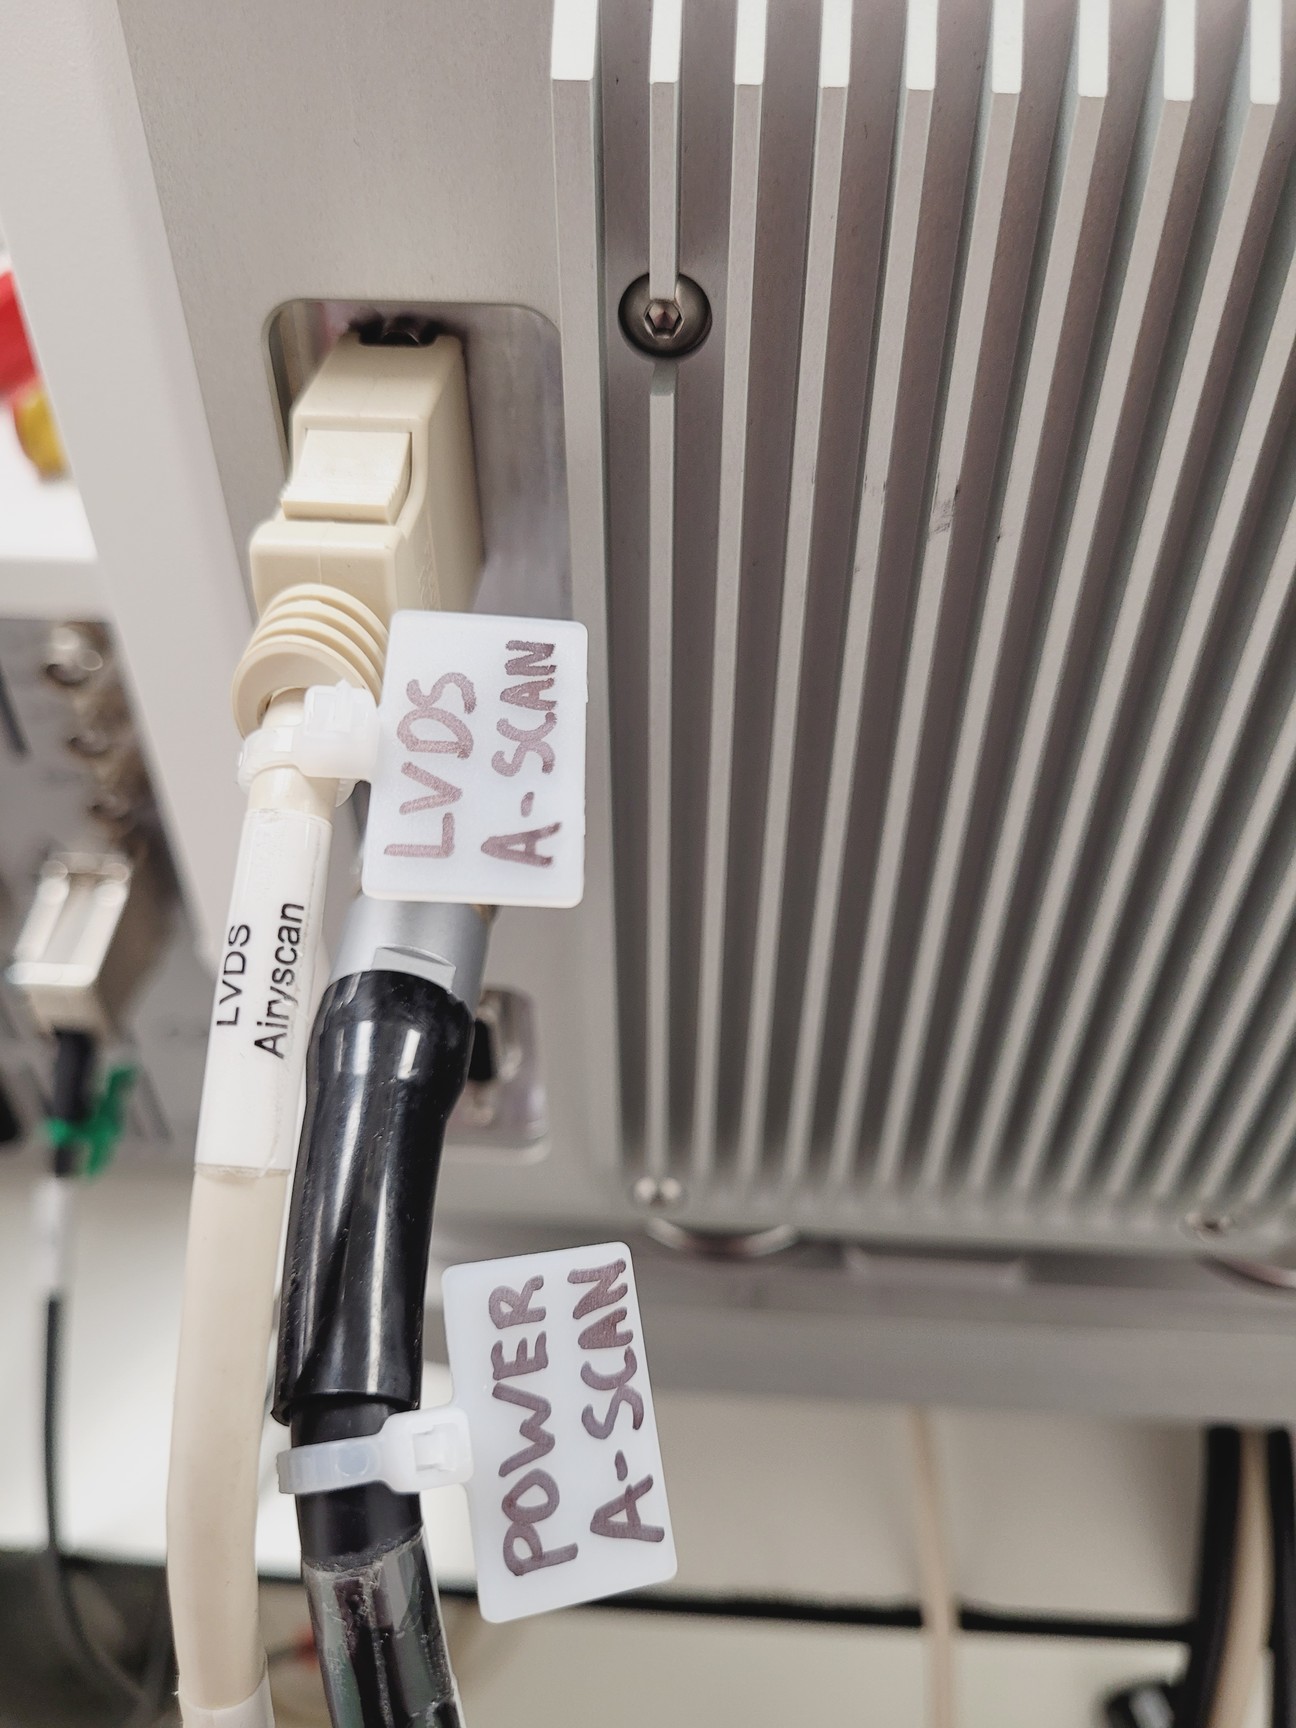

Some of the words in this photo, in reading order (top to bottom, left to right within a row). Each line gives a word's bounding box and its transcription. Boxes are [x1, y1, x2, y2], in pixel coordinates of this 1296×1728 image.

[384, 672, 477, 859] LVDS
[216, 924, 251, 1027] LVDS
[254, 903, 305, 1059] Airyscan
[488, 1274, 578, 1577] POWER
